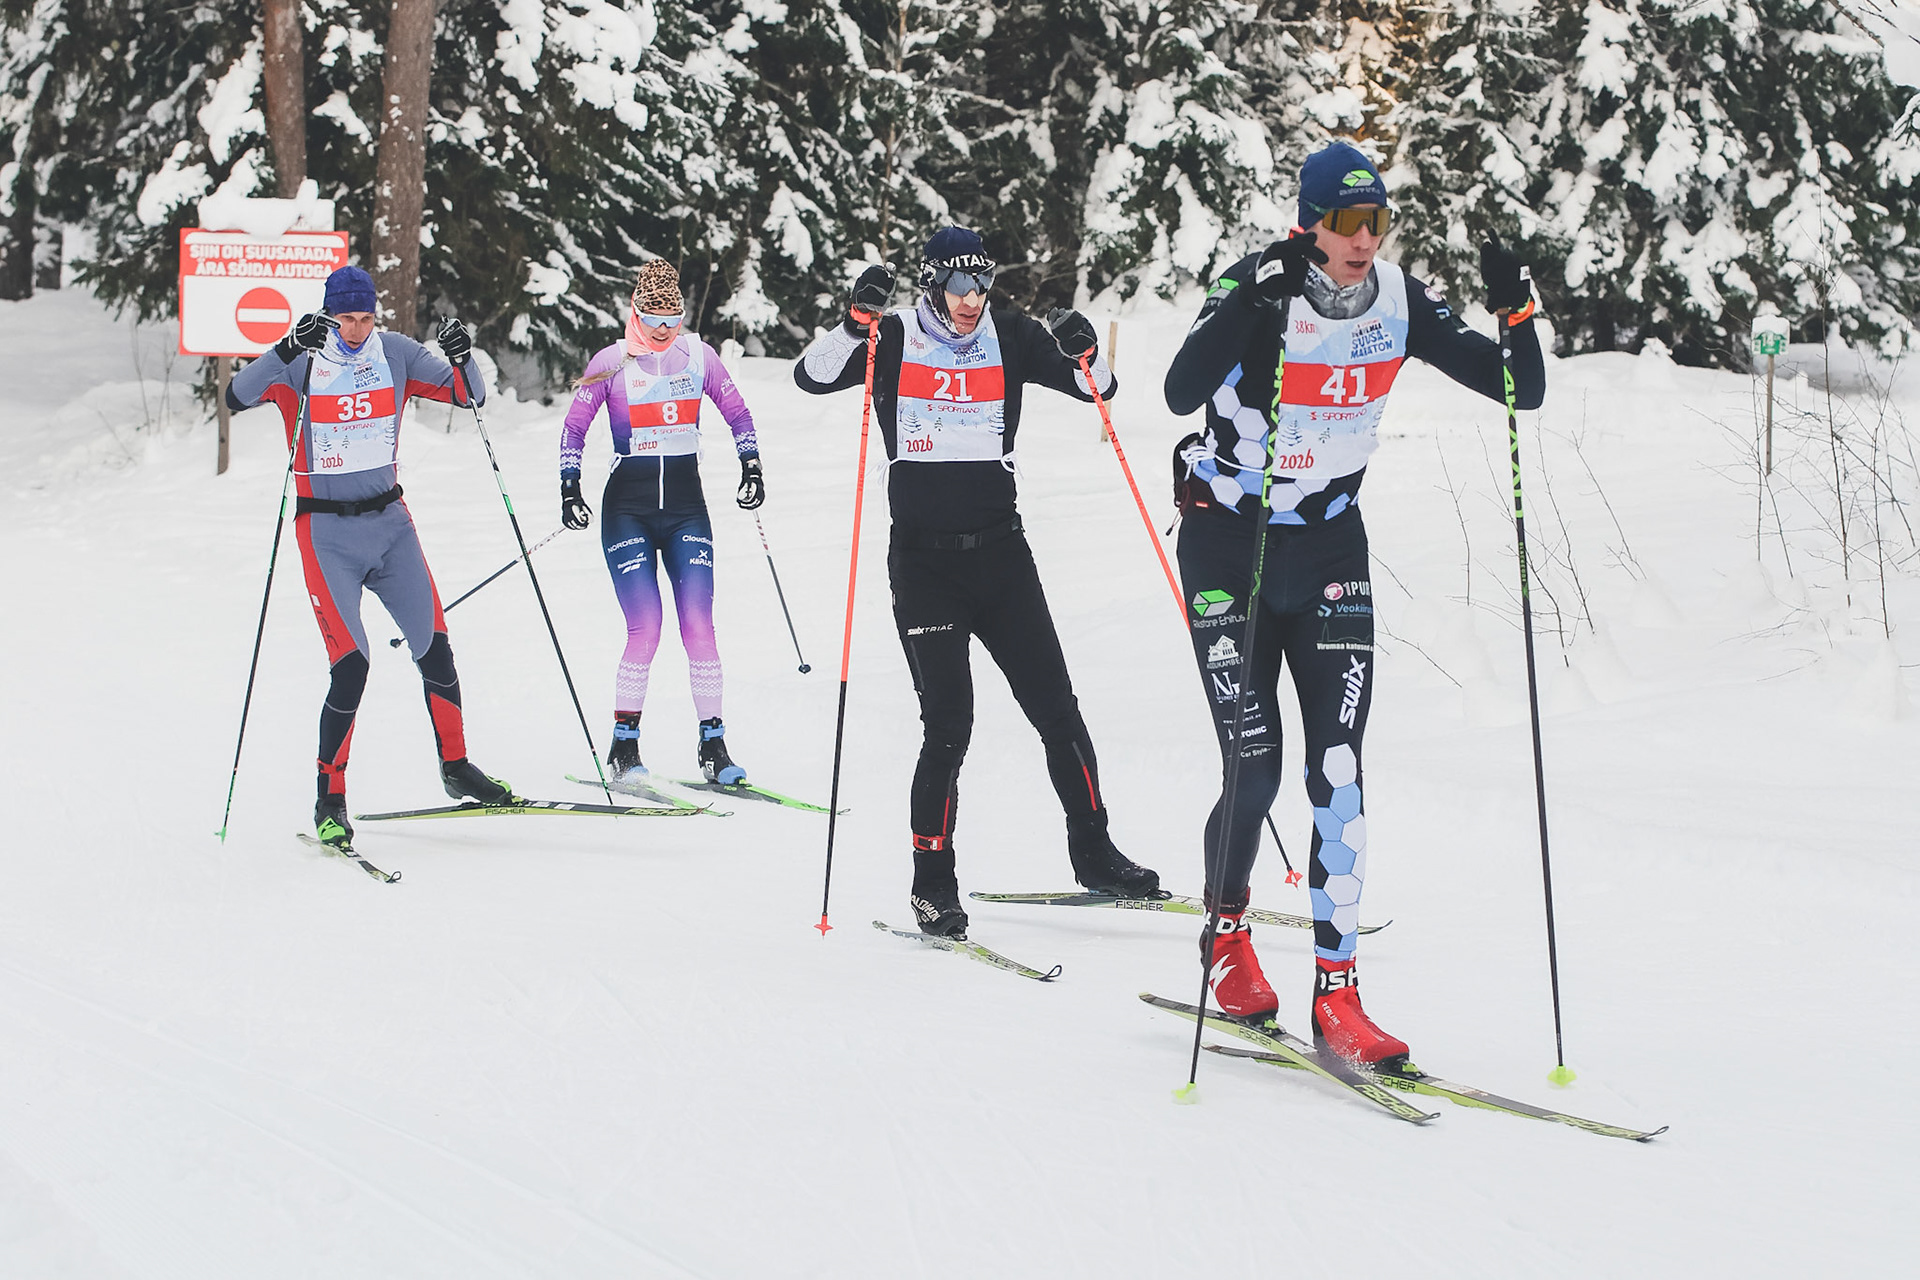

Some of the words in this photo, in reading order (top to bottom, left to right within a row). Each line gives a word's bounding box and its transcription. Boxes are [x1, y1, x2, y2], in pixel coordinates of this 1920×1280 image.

[190, 244, 218, 259] SIIN
[221, 245, 243, 259] ON
[245, 246, 340, 264] SUUSARADA,
[195, 257, 226, 276] ÄRA
[227, 260, 273, 277] SÕIDA
[274, 263, 333, 279] AUTOGA
[933, 371, 974, 402] 21
[1320, 366, 1370, 405] 41
[337, 392, 373, 421] 35
[662, 402, 679, 424] 8
[937, 405, 981, 414] SPORTLAND
[905, 434, 934, 453] 2026
[320, 453, 344, 469] 2026
[1279, 448, 1315, 470] 2026
[607, 536, 646, 554] NORDESS
[485, 808, 526, 816] FISCHER
[1115, 900, 1164, 912] FISCHER
[1239, 1027, 1272, 1048] FISCHER
